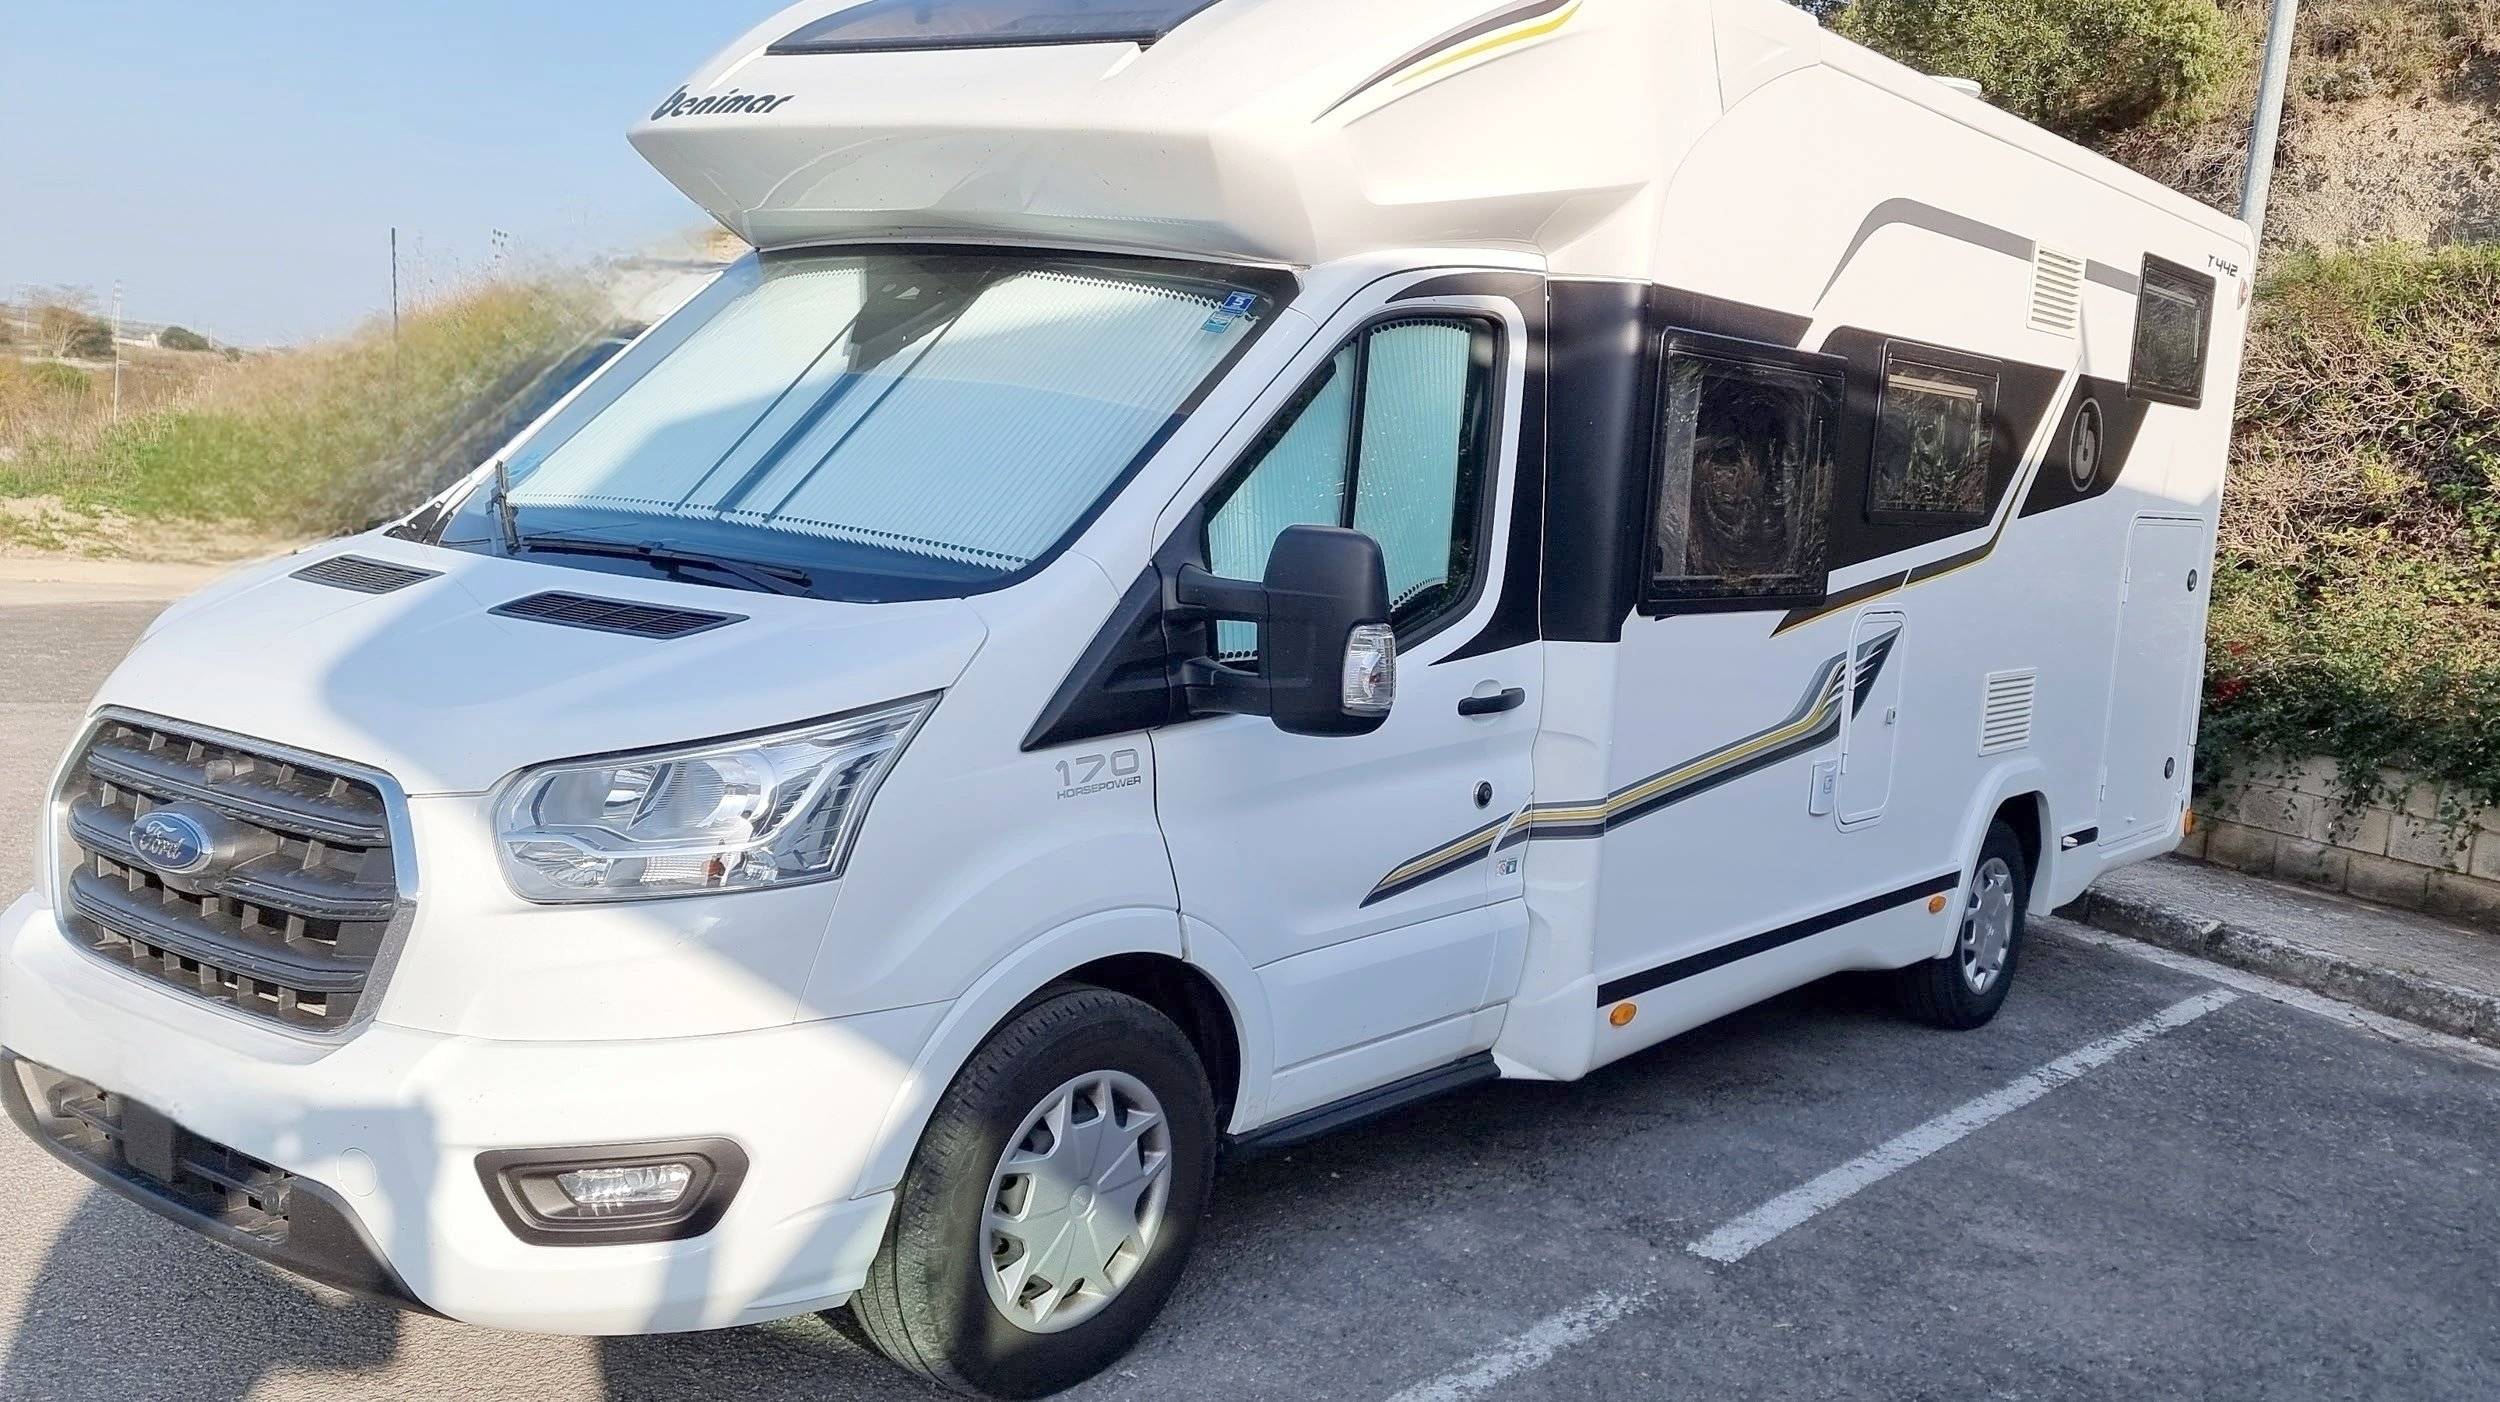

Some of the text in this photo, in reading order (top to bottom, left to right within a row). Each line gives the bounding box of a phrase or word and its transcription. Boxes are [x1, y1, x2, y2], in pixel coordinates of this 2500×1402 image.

[1055, 748, 1140, 787] 170
[1056, 775, 1142, 800] HORSEPOWER
[140, 820, 185, 860] Ford
